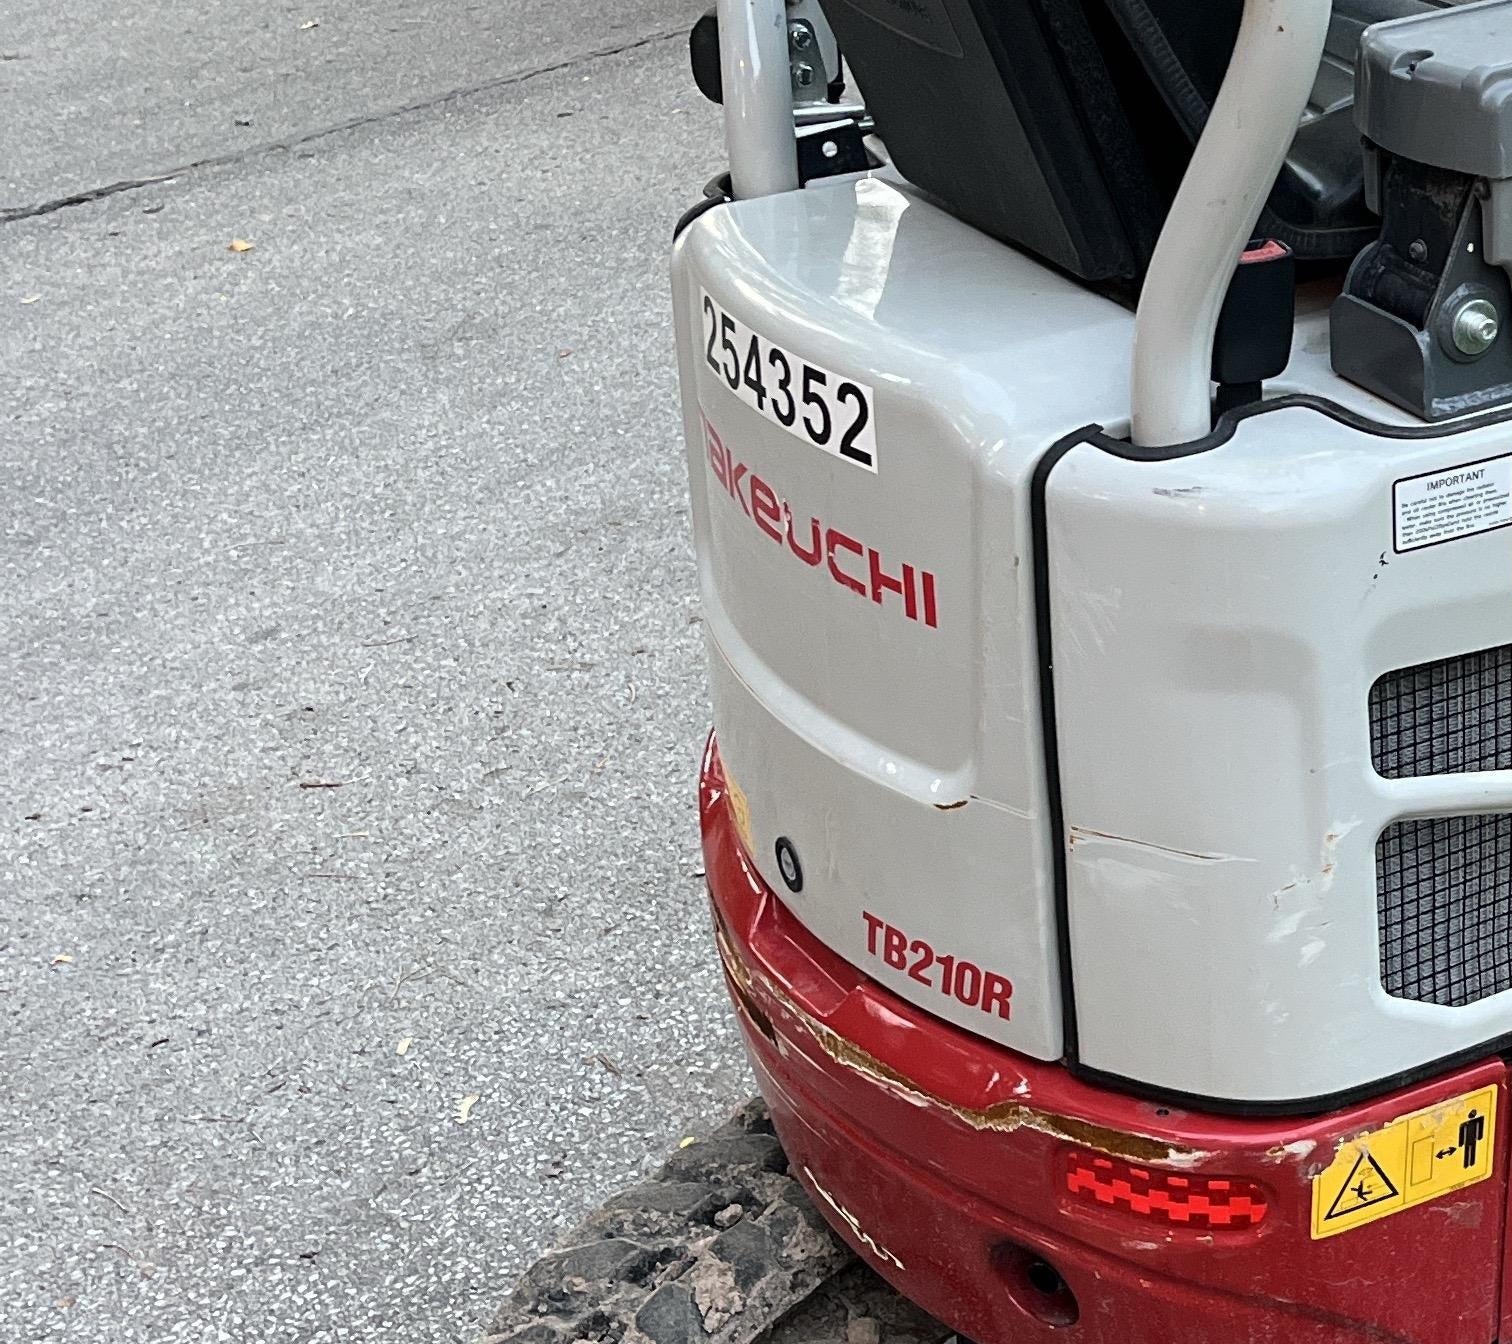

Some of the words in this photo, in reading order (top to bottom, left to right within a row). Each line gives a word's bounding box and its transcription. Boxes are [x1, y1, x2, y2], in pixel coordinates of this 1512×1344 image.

[703, 295, 873, 467] 254352
[1426, 468, 1486, 491] IMPORTANT
[862, 910, 1013, 1022] TB210R
